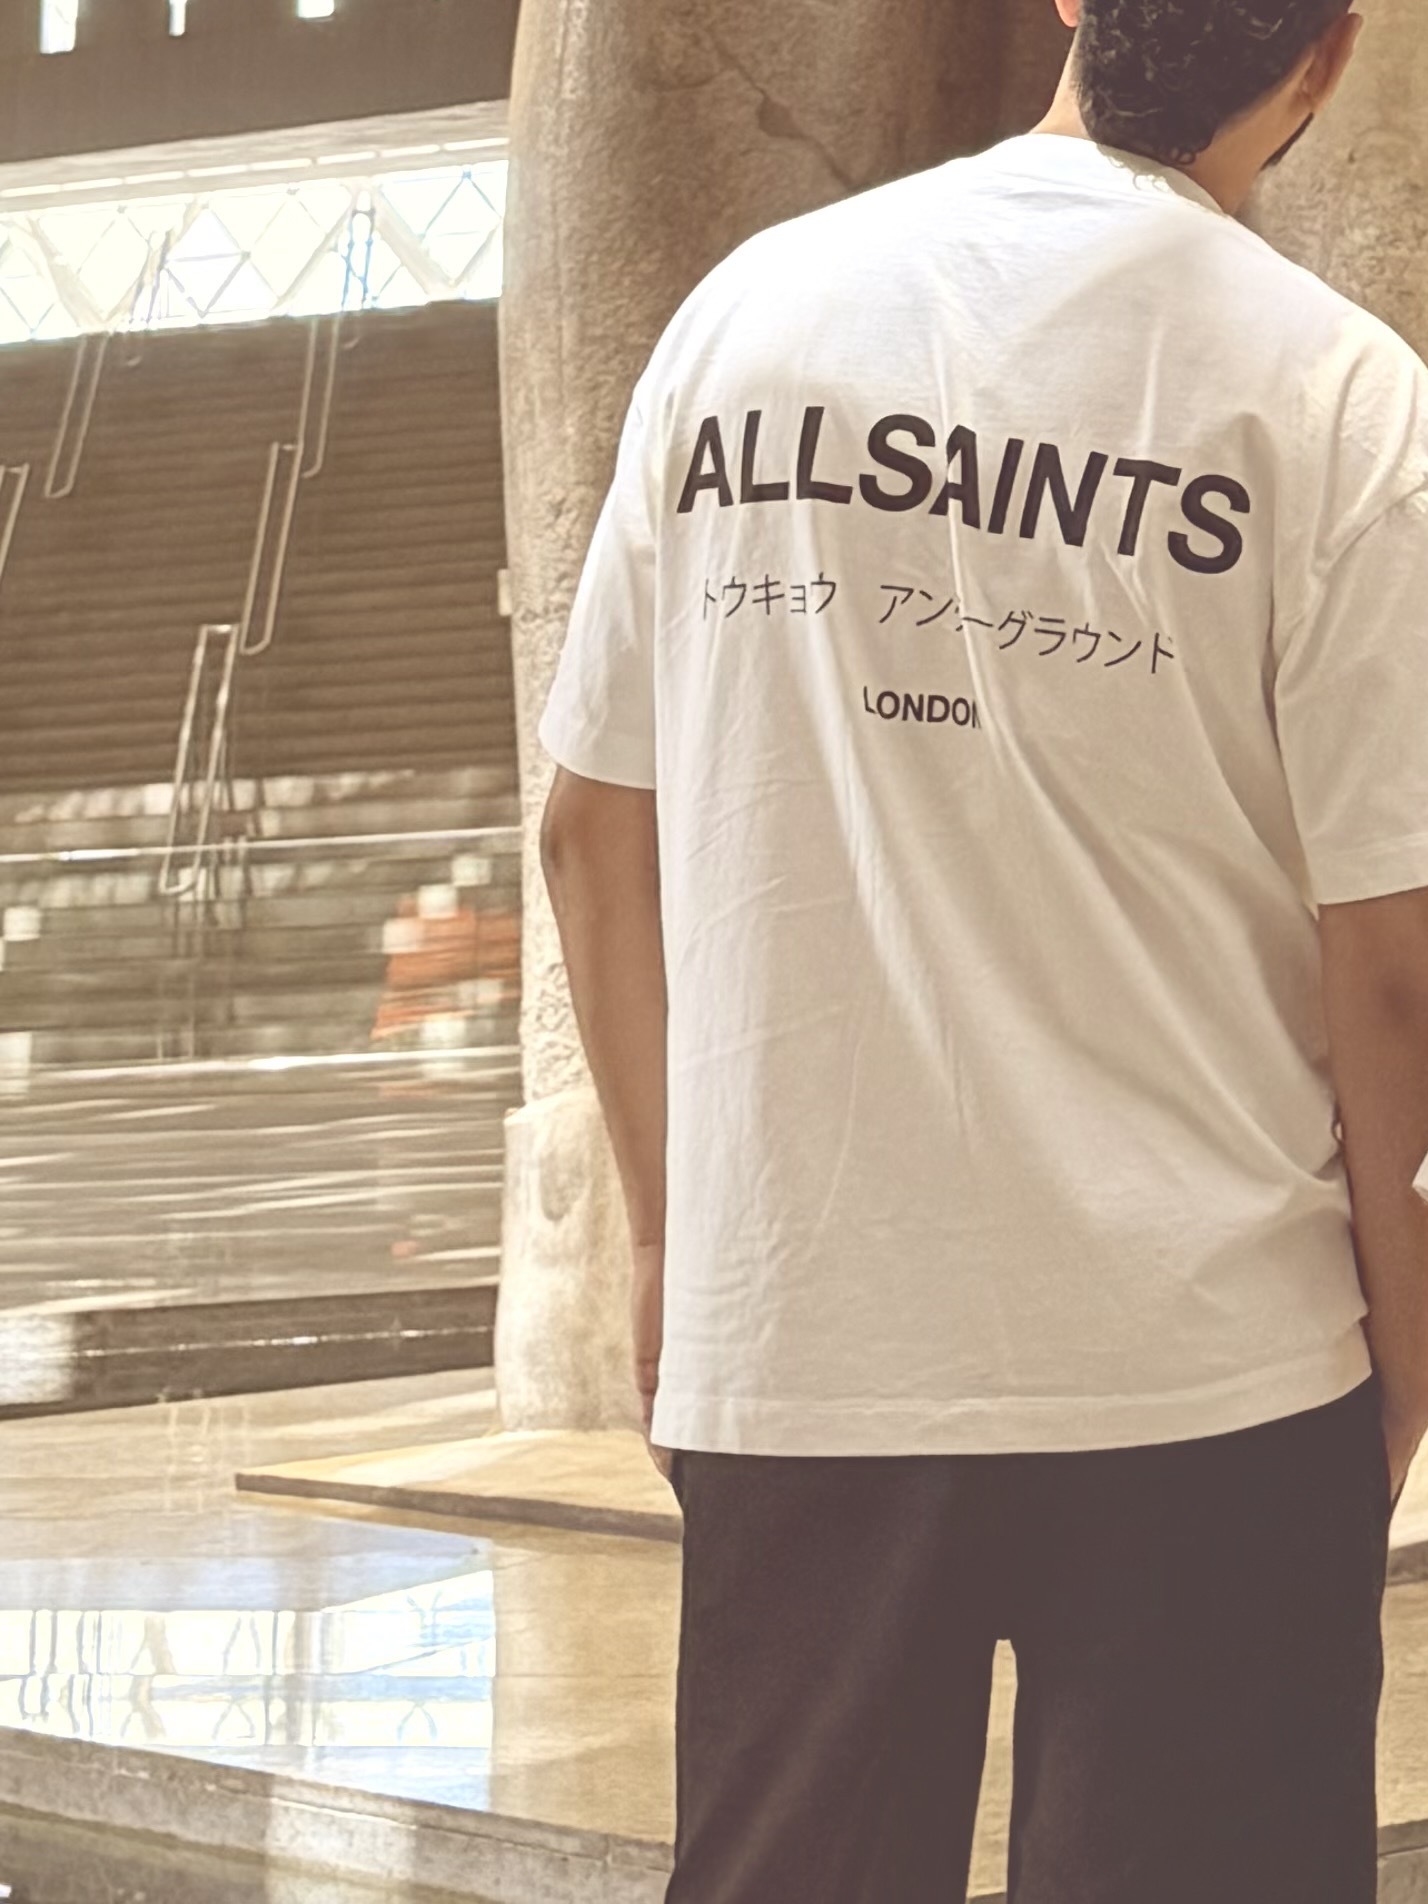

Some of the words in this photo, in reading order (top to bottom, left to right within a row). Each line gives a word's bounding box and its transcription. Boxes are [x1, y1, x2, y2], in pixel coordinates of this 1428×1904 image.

[674, 404, 1252, 576] ALLSAINTS
[702, 570, 840, 622] トウキョウ
[878, 583, 1176, 676] アンーグラウンド
